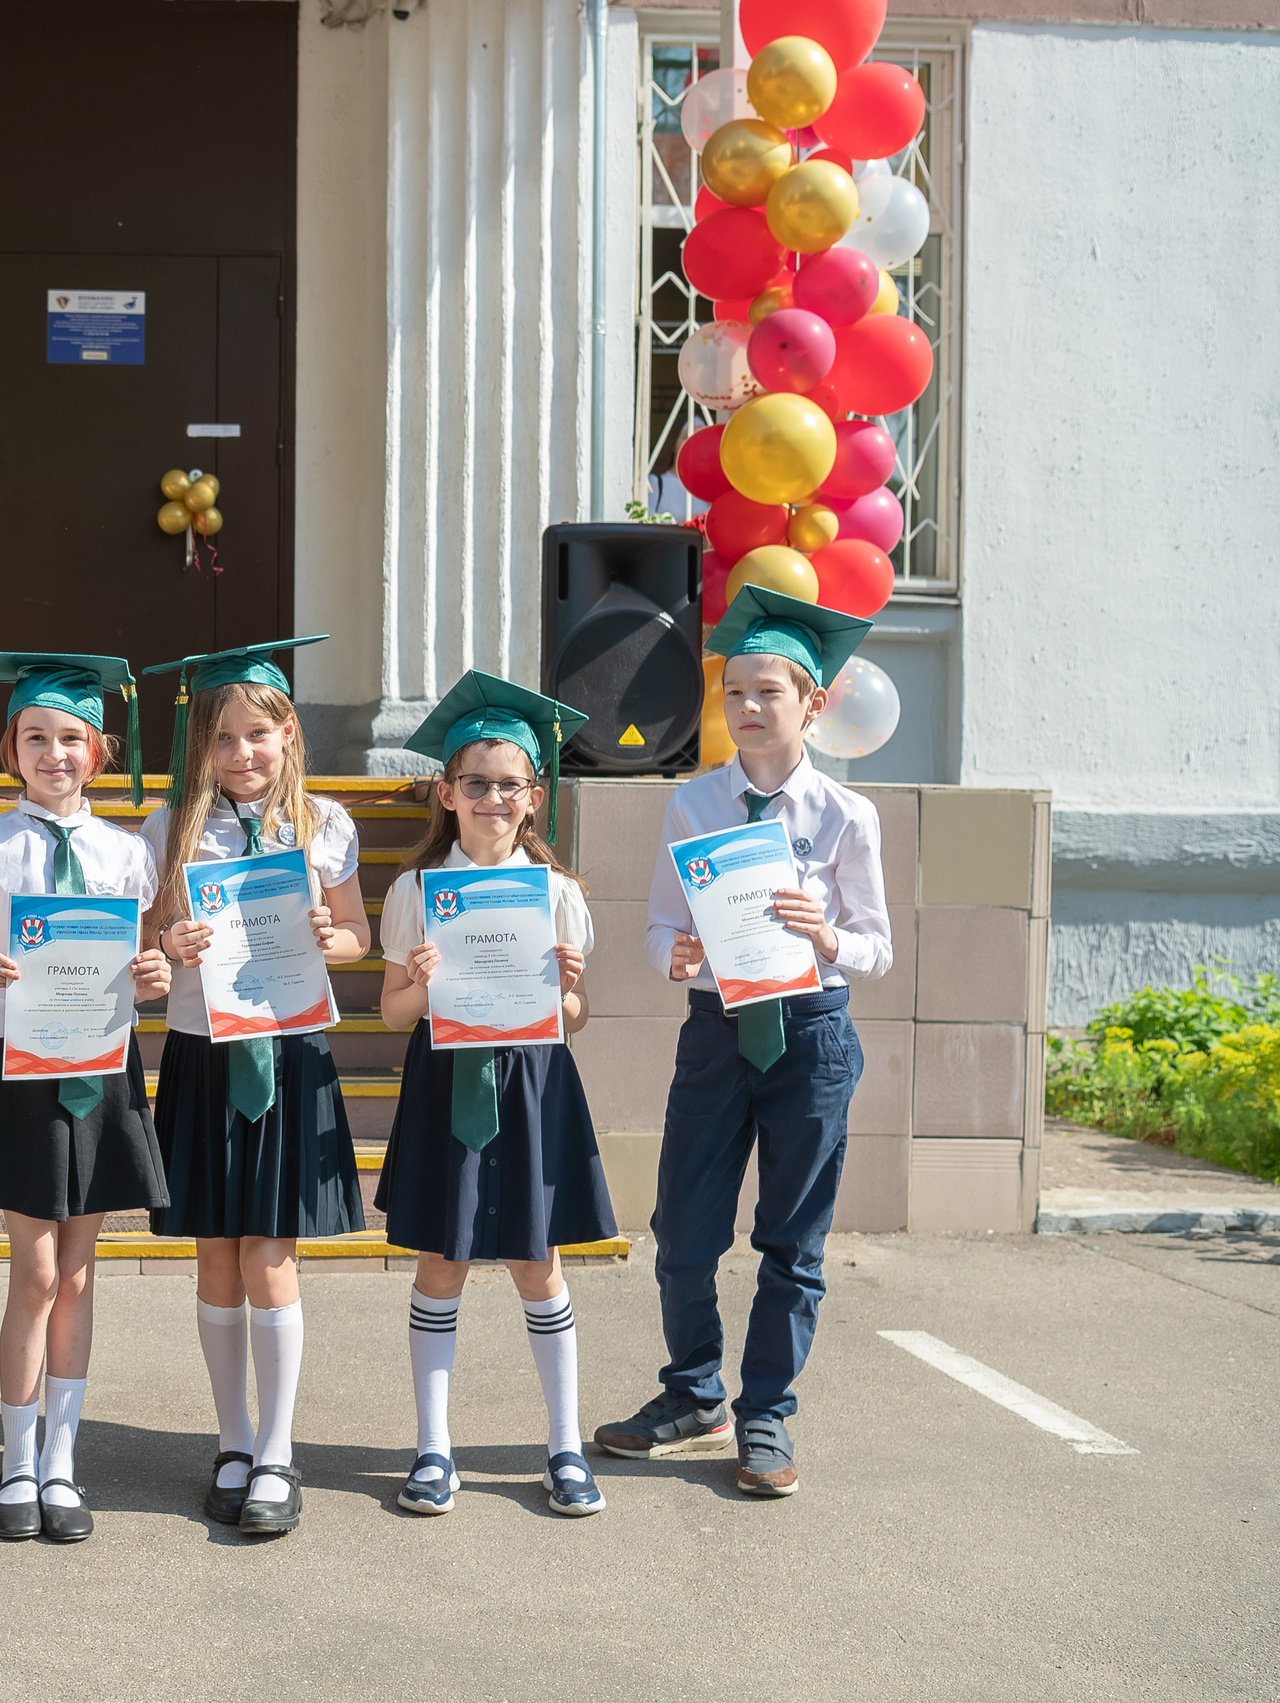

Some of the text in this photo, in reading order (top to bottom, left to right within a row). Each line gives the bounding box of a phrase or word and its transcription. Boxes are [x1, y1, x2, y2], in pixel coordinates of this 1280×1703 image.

[727, 887, 775, 905] ГРАМОТА
[230, 914, 281, 929] ГРАМОТА
[465, 933, 517, 944] ГРАМОТА
[47, 966, 100, 976] ГРАМОТА
